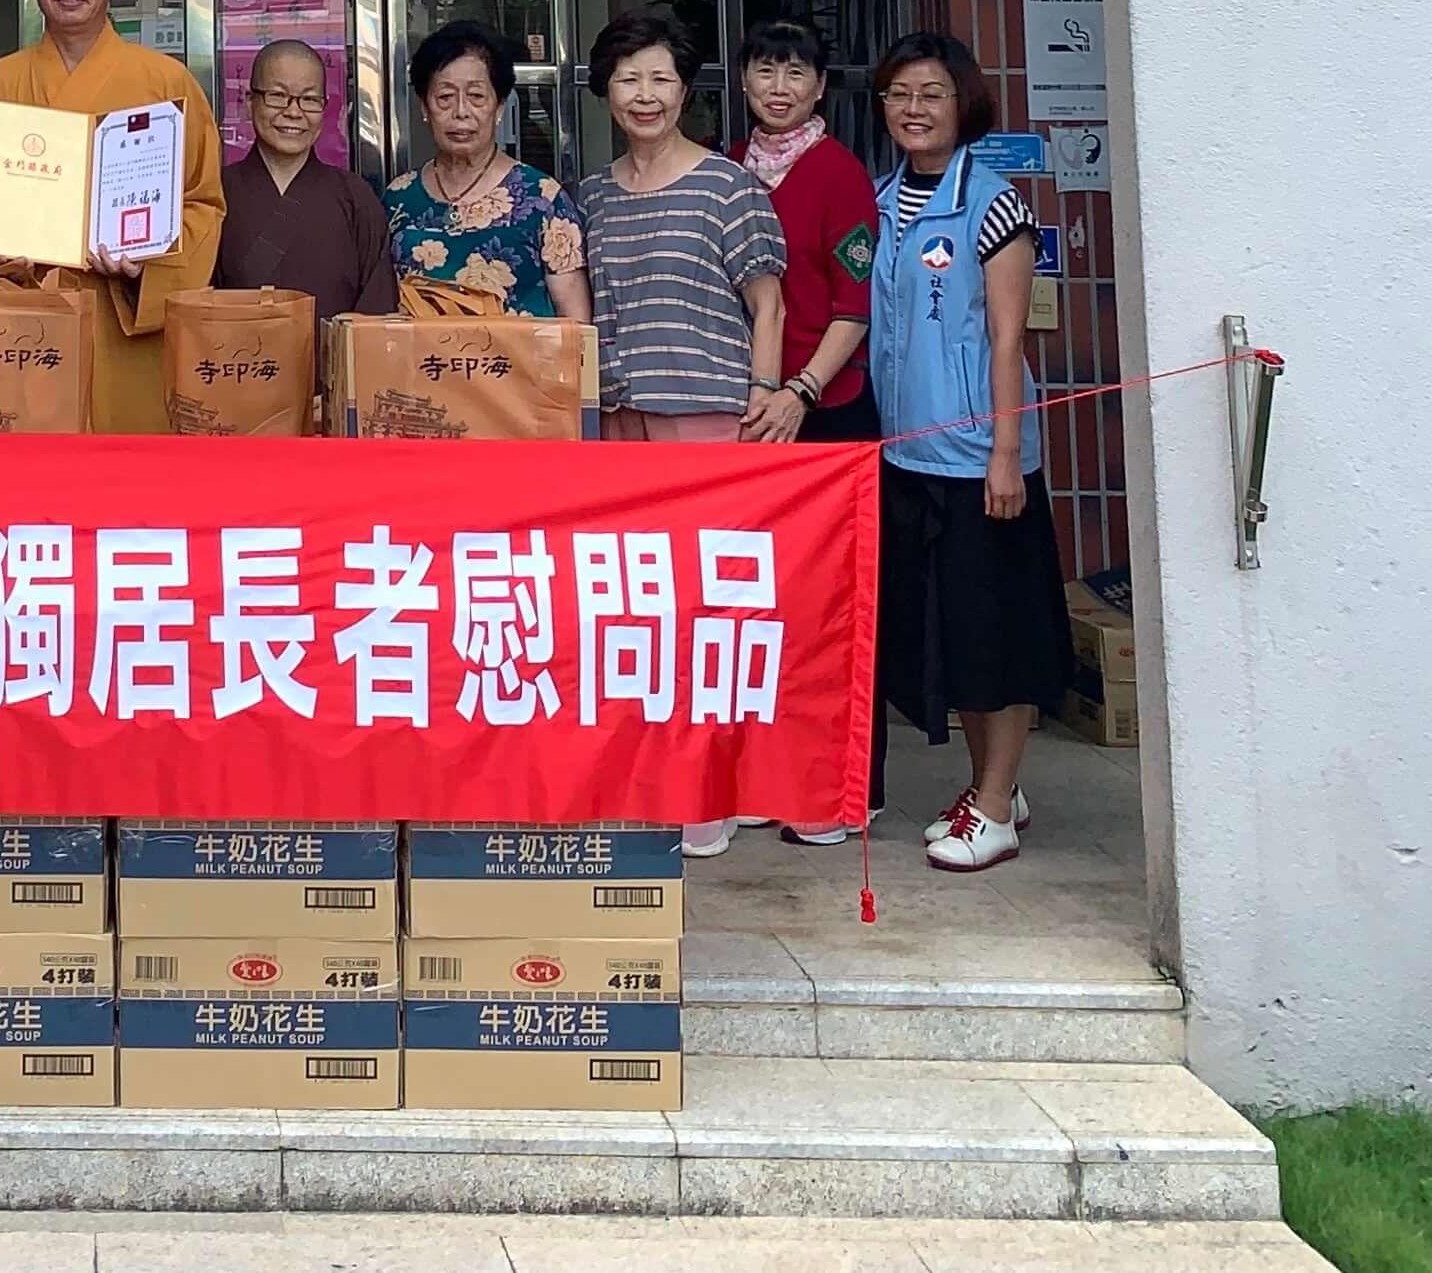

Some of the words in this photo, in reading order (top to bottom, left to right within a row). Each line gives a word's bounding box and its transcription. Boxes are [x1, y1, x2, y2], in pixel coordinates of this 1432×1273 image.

[194, 833, 324, 863] 牛奶花生
[485, 833, 613, 863] 牛奶花生
[195, 864, 226, 875] MILK
[230, 864, 282, 875] PEANUT
[287, 864, 323, 875] SOUP
[486, 864, 516, 875] MILK
[521, 864, 572, 875] PEANUT
[577, 864, 612, 875] SOUP
[195, 1003, 326, 1033] 牛奶花生
[479, 1004, 610, 1034] 牛奶花生
[6, 1031, 41, 1042] SOUP
[195, 1034, 227, 1045] MILK
[232, 1034, 284, 1045] PEANUT
[288, 1034, 325, 1045] SOUP
[480, 1035, 511, 1046] MILK
[516, 1035, 568, 1046] PEANUT
[573, 1035, 608, 1046] SOUP
